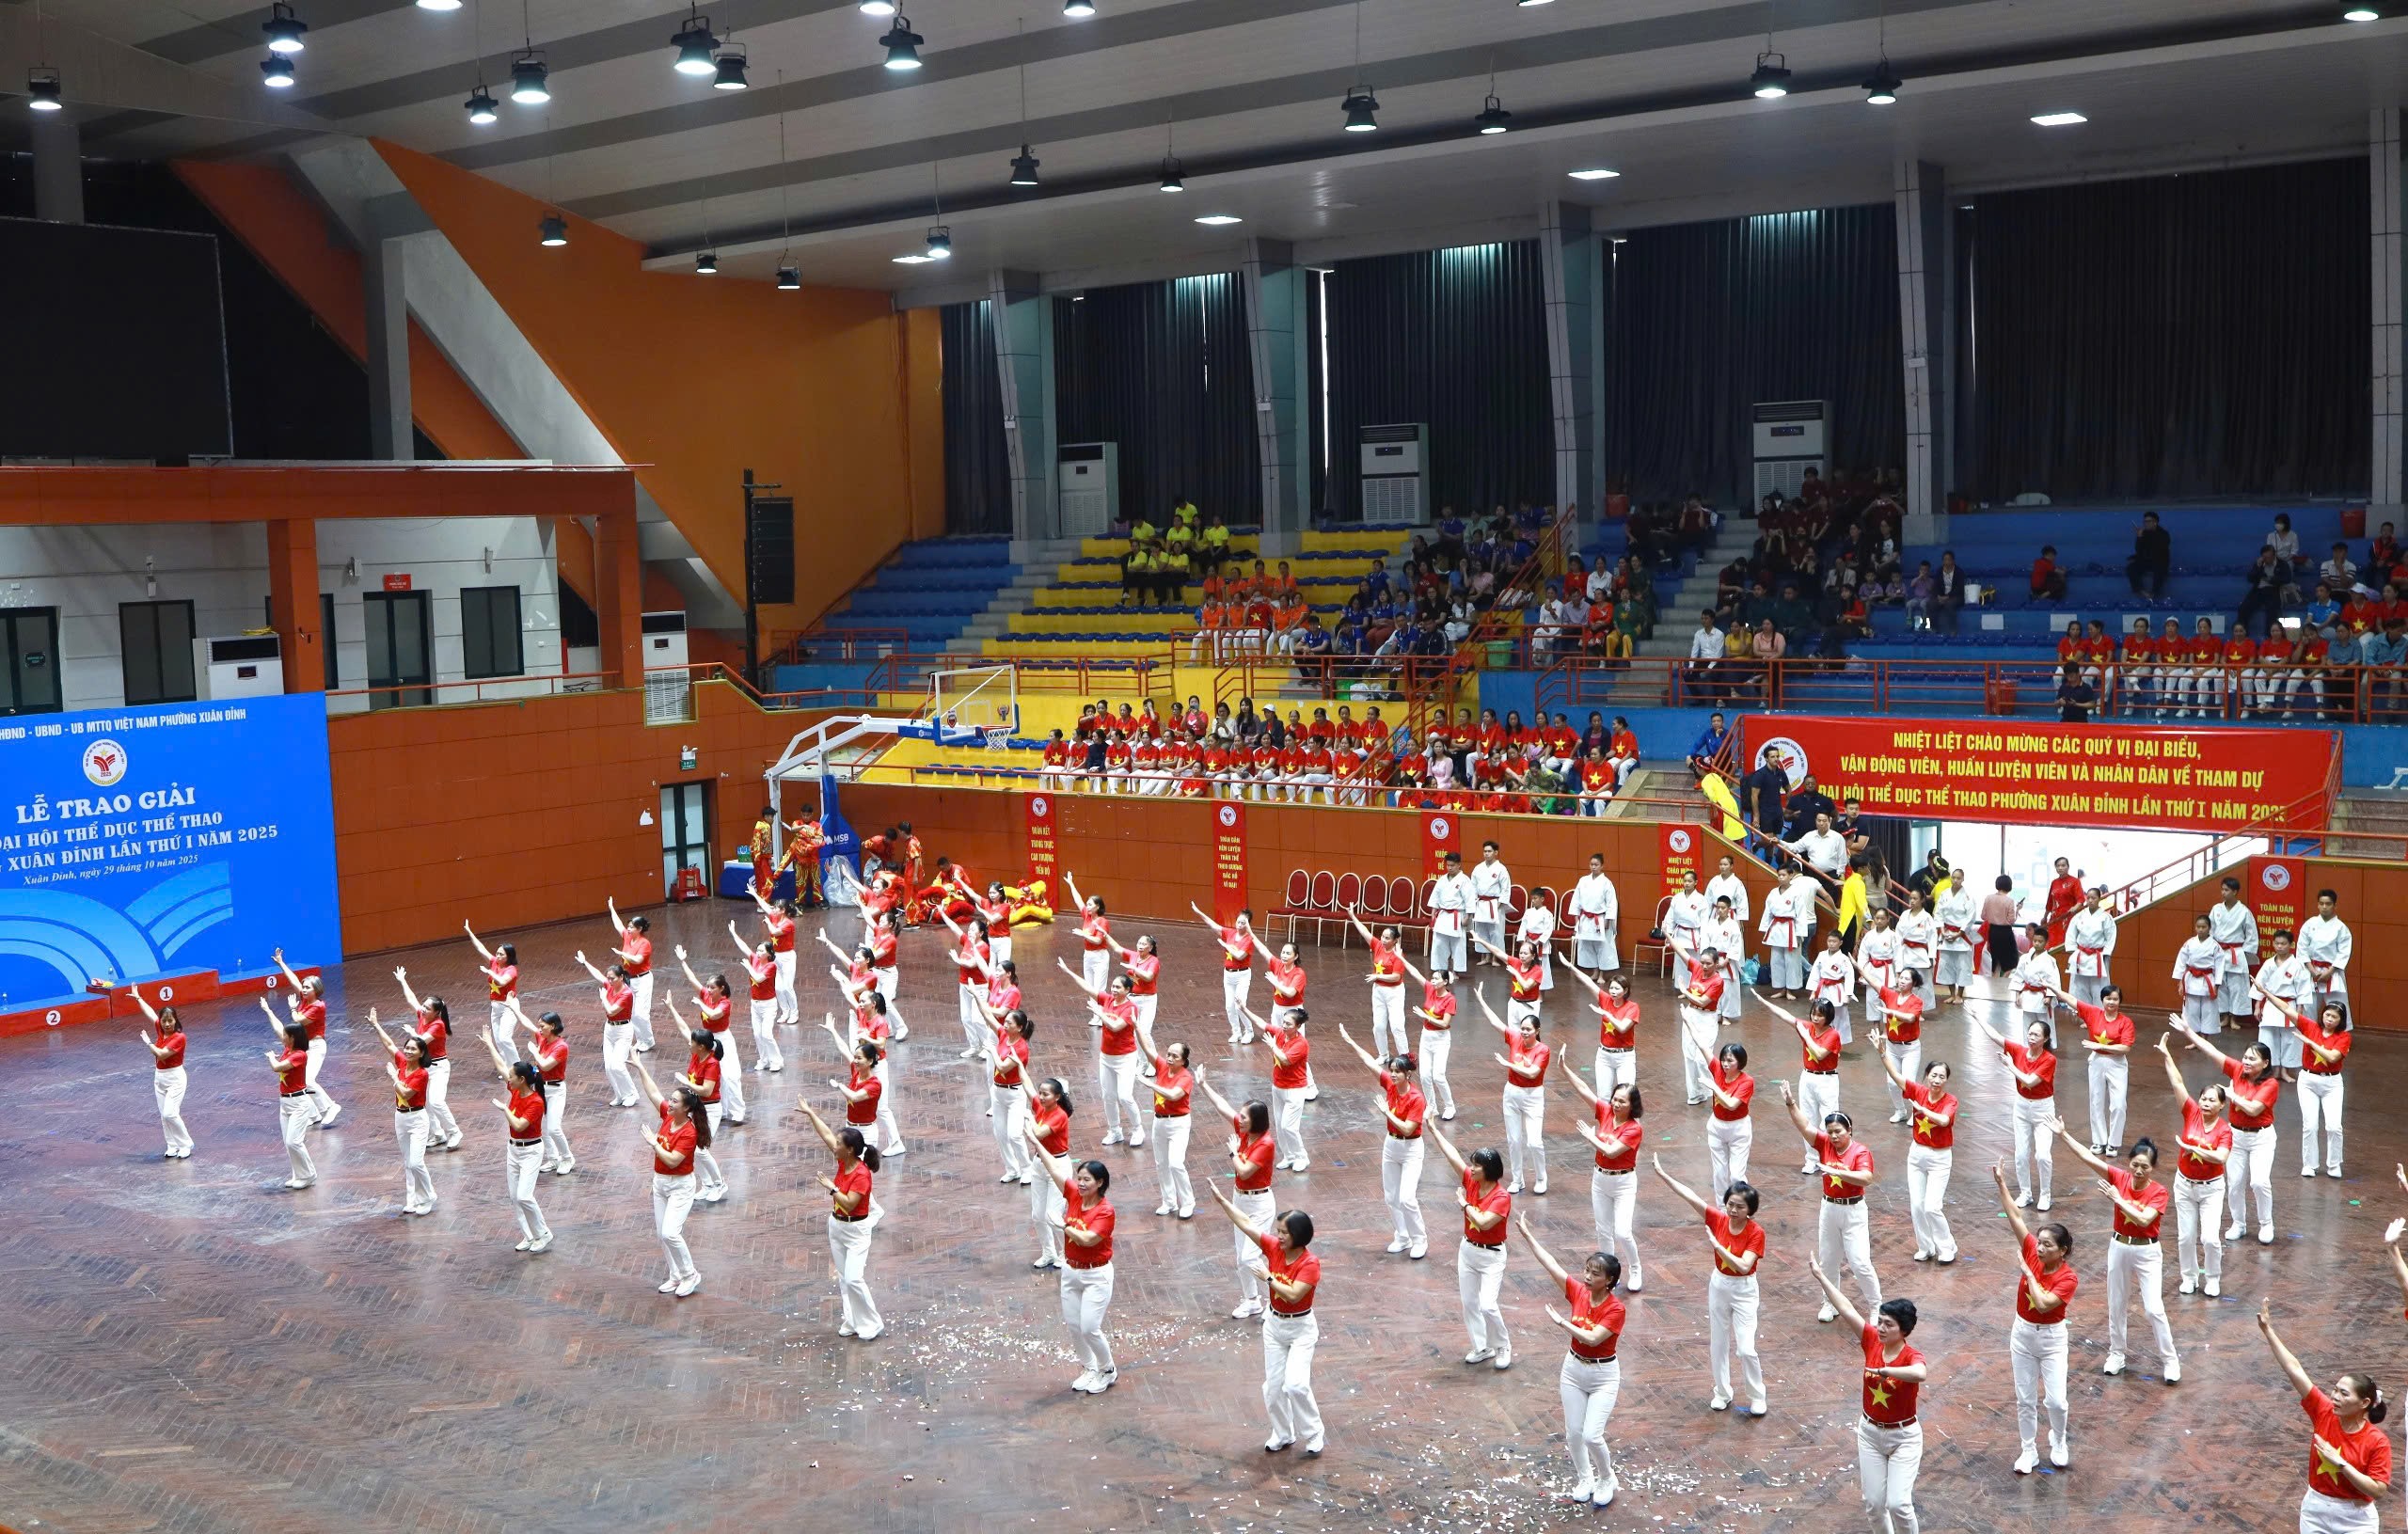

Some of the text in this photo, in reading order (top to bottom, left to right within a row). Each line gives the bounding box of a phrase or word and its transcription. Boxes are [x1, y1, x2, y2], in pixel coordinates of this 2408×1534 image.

[35, 724, 62, 737] UBND
[71, 721, 84, 735] UB
[87, 720, 112, 734] MTTQ
[114, 716, 134, 732] VIỆT
[135, 716, 158, 729] NAM
[160, 711, 197, 726] PHƯỜNG
[198, 709, 223, 723] XUÂN
[225, 705, 246, 721] ĐỈNH
[1893, 730, 2201, 760] NHIỆT LIỆT CHÀO MỪNG CÁC QUÝ VỊ ĐẠI BIỂU,
[1841, 753, 2264, 792] VẬN ĐỘNG VIÊN, HUẤN LUYỆN VIÊN VÀ NHÂN DÂN VỀ THAM DỰ
[15, 782, 196, 824] LỄ TRAO GIẢI
[1868, 781, 1893, 803] THỂ
[1895, 787, 1922, 807] DỤC
[1925, 783, 1950, 806] THỂ
[1953, 789, 1988, 808] THAO
[1991, 789, 2048, 811] PHƯỜNG
[2051, 793, 2090, 813] XUÂN
[2094, 791, 2129, 814] ĐỈNH
[2132, 794, 2161, 816] LẦN
[2165, 798, 2195, 817] THỨ
[2197, 801, 2206, 818] I
[2211, 799, 2247, 820] NĂM
[26, 829, 59, 847] HỘI
[64, 821, 99, 843] THỂ
[103, 821, 137, 838] DỤC
[142, 812, 175, 833] THỂ
[180, 812, 223, 828] THAO
[833, 833, 849, 843] MSB
[8, 851, 55, 872] XUÂN
[61, 846, 104, 864] ĐỈNH
[110, 839, 142, 858] LẦN
[147, 834, 182, 853] THỨ
[186, 835, 193, 848] I
[198, 830, 232, 847] NĂM
[237, 825, 278, 843] 2025
[24, 875, 49, 885] Xuân
[80, 867, 102, 880] ngày
[103, 865, 114, 876] 29
[117, 862, 142, 873] tháng
[145, 861, 155, 869] 10
[156, 859, 176, 868] năm
[178, 854, 198, 865] 2025
[1666, 866, 1680, 875] CHÀO
[1668, 857, 1693, 865] NHIỆT LIỆT
[2259, 903, 2294, 913] TOÀN DÂN
[2257, 914, 2294, 925] RÈN LUYỆN
[268, 976, 276, 988] 3
[163, 988, 170, 1000] 1
[50, 1012, 57, 1024] 2
